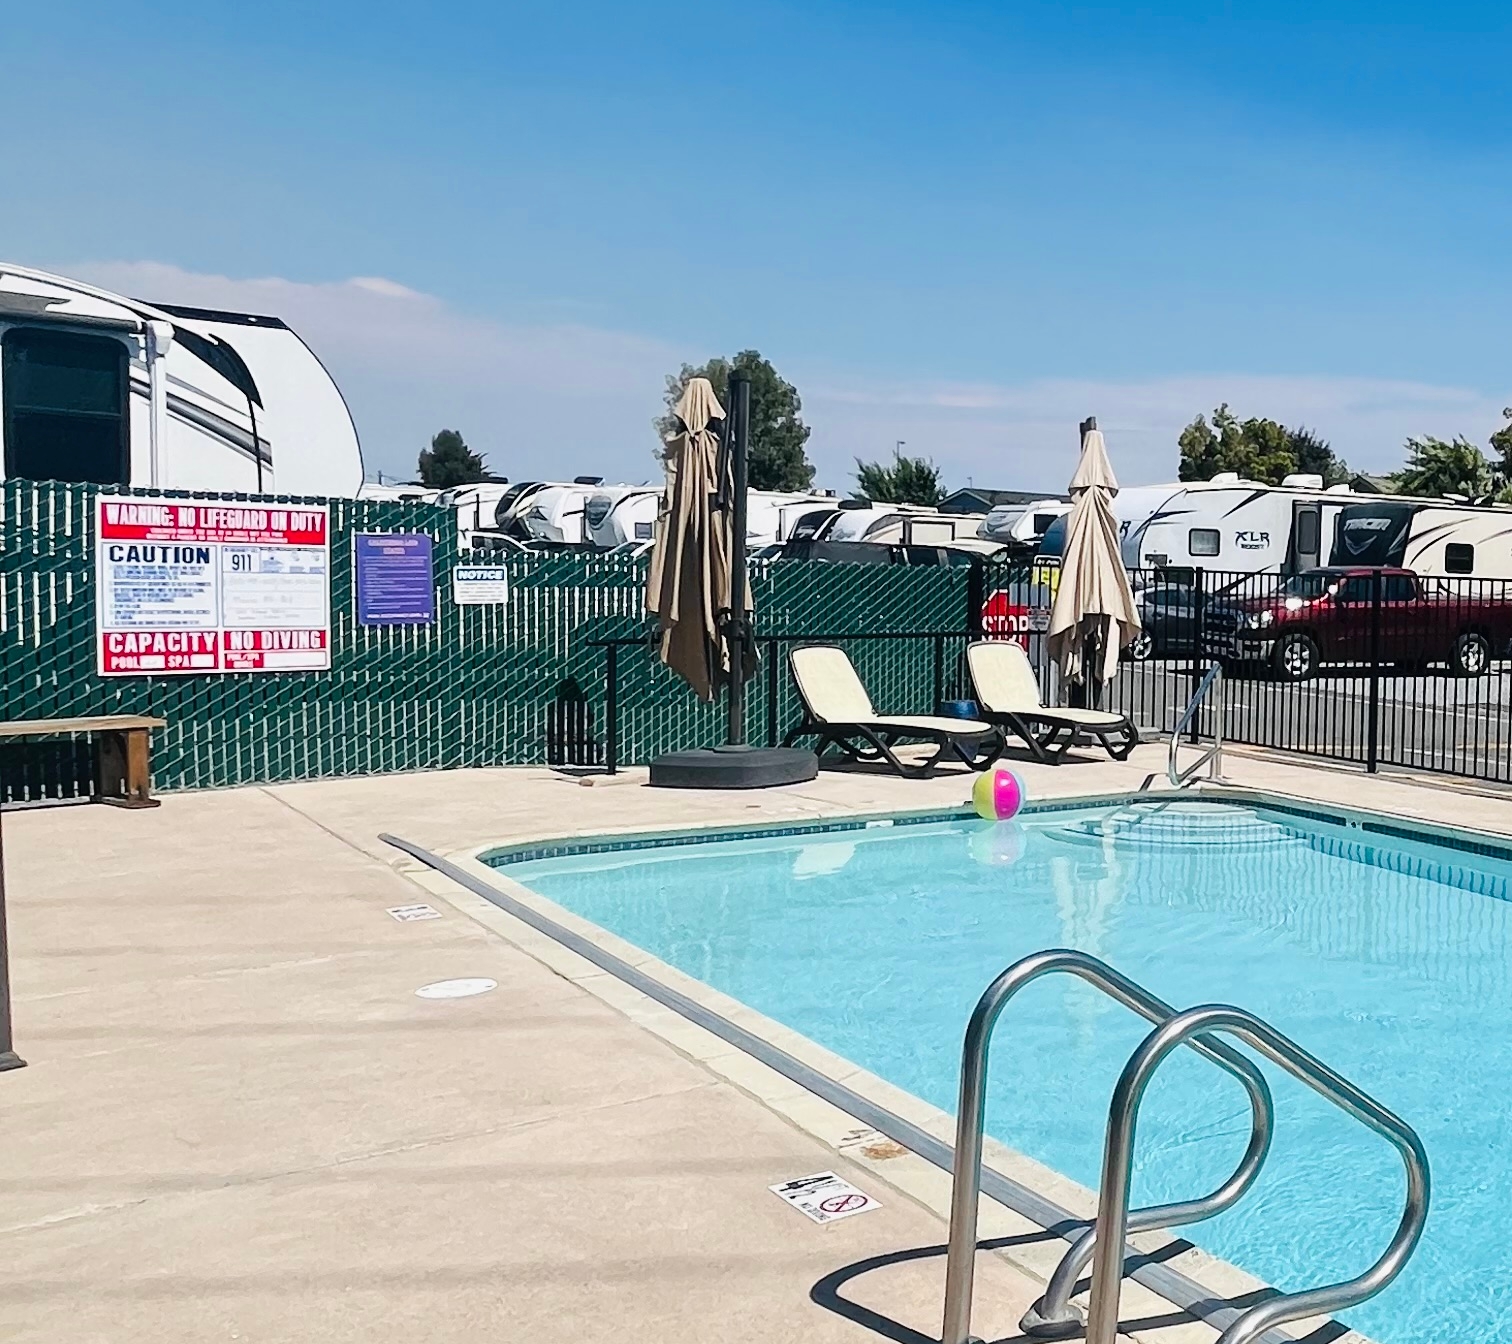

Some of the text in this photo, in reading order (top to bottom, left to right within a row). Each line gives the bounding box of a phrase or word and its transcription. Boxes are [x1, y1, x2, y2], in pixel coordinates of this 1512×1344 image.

[105, 504, 323, 532] WARNING: NO LIFEGUARD ON DUTY
[1343, 518, 1392, 531] TRACER
[1235, 531, 1270, 548] XLR
[109, 545, 210, 564] CAUTION
[231, 554, 252, 571] 911
[458, 570, 503, 580] NOTICE
[108, 632, 216, 653] CAPACITY
[230, 630, 321, 649] NO DIVING
[168, 655, 191, 668] SPA
